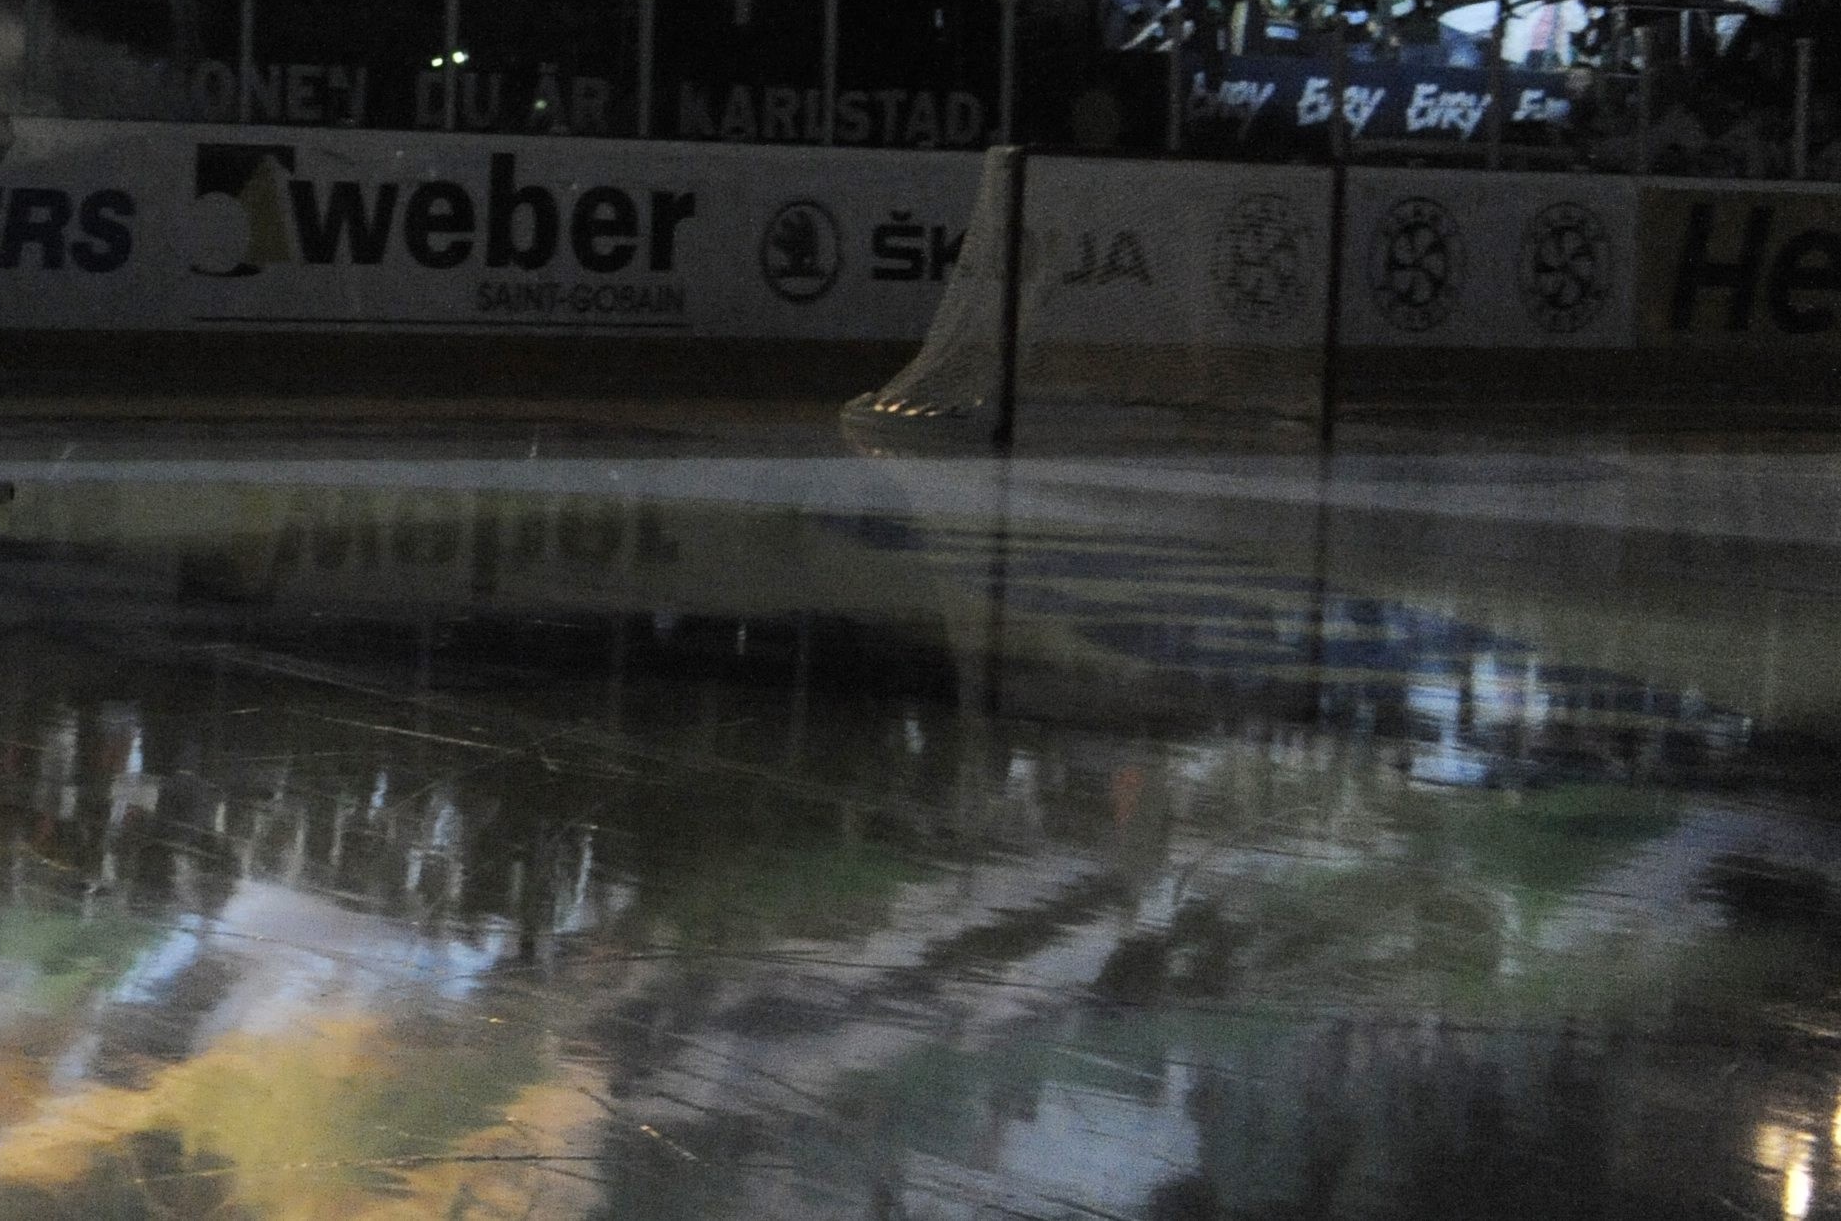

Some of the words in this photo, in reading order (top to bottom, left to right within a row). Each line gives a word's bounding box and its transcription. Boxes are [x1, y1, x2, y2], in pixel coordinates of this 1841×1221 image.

[414, 70, 501, 129] DU
[294, 154, 695, 272] weber
[476, 282, 686, 315] SAINT-GOBAIN
